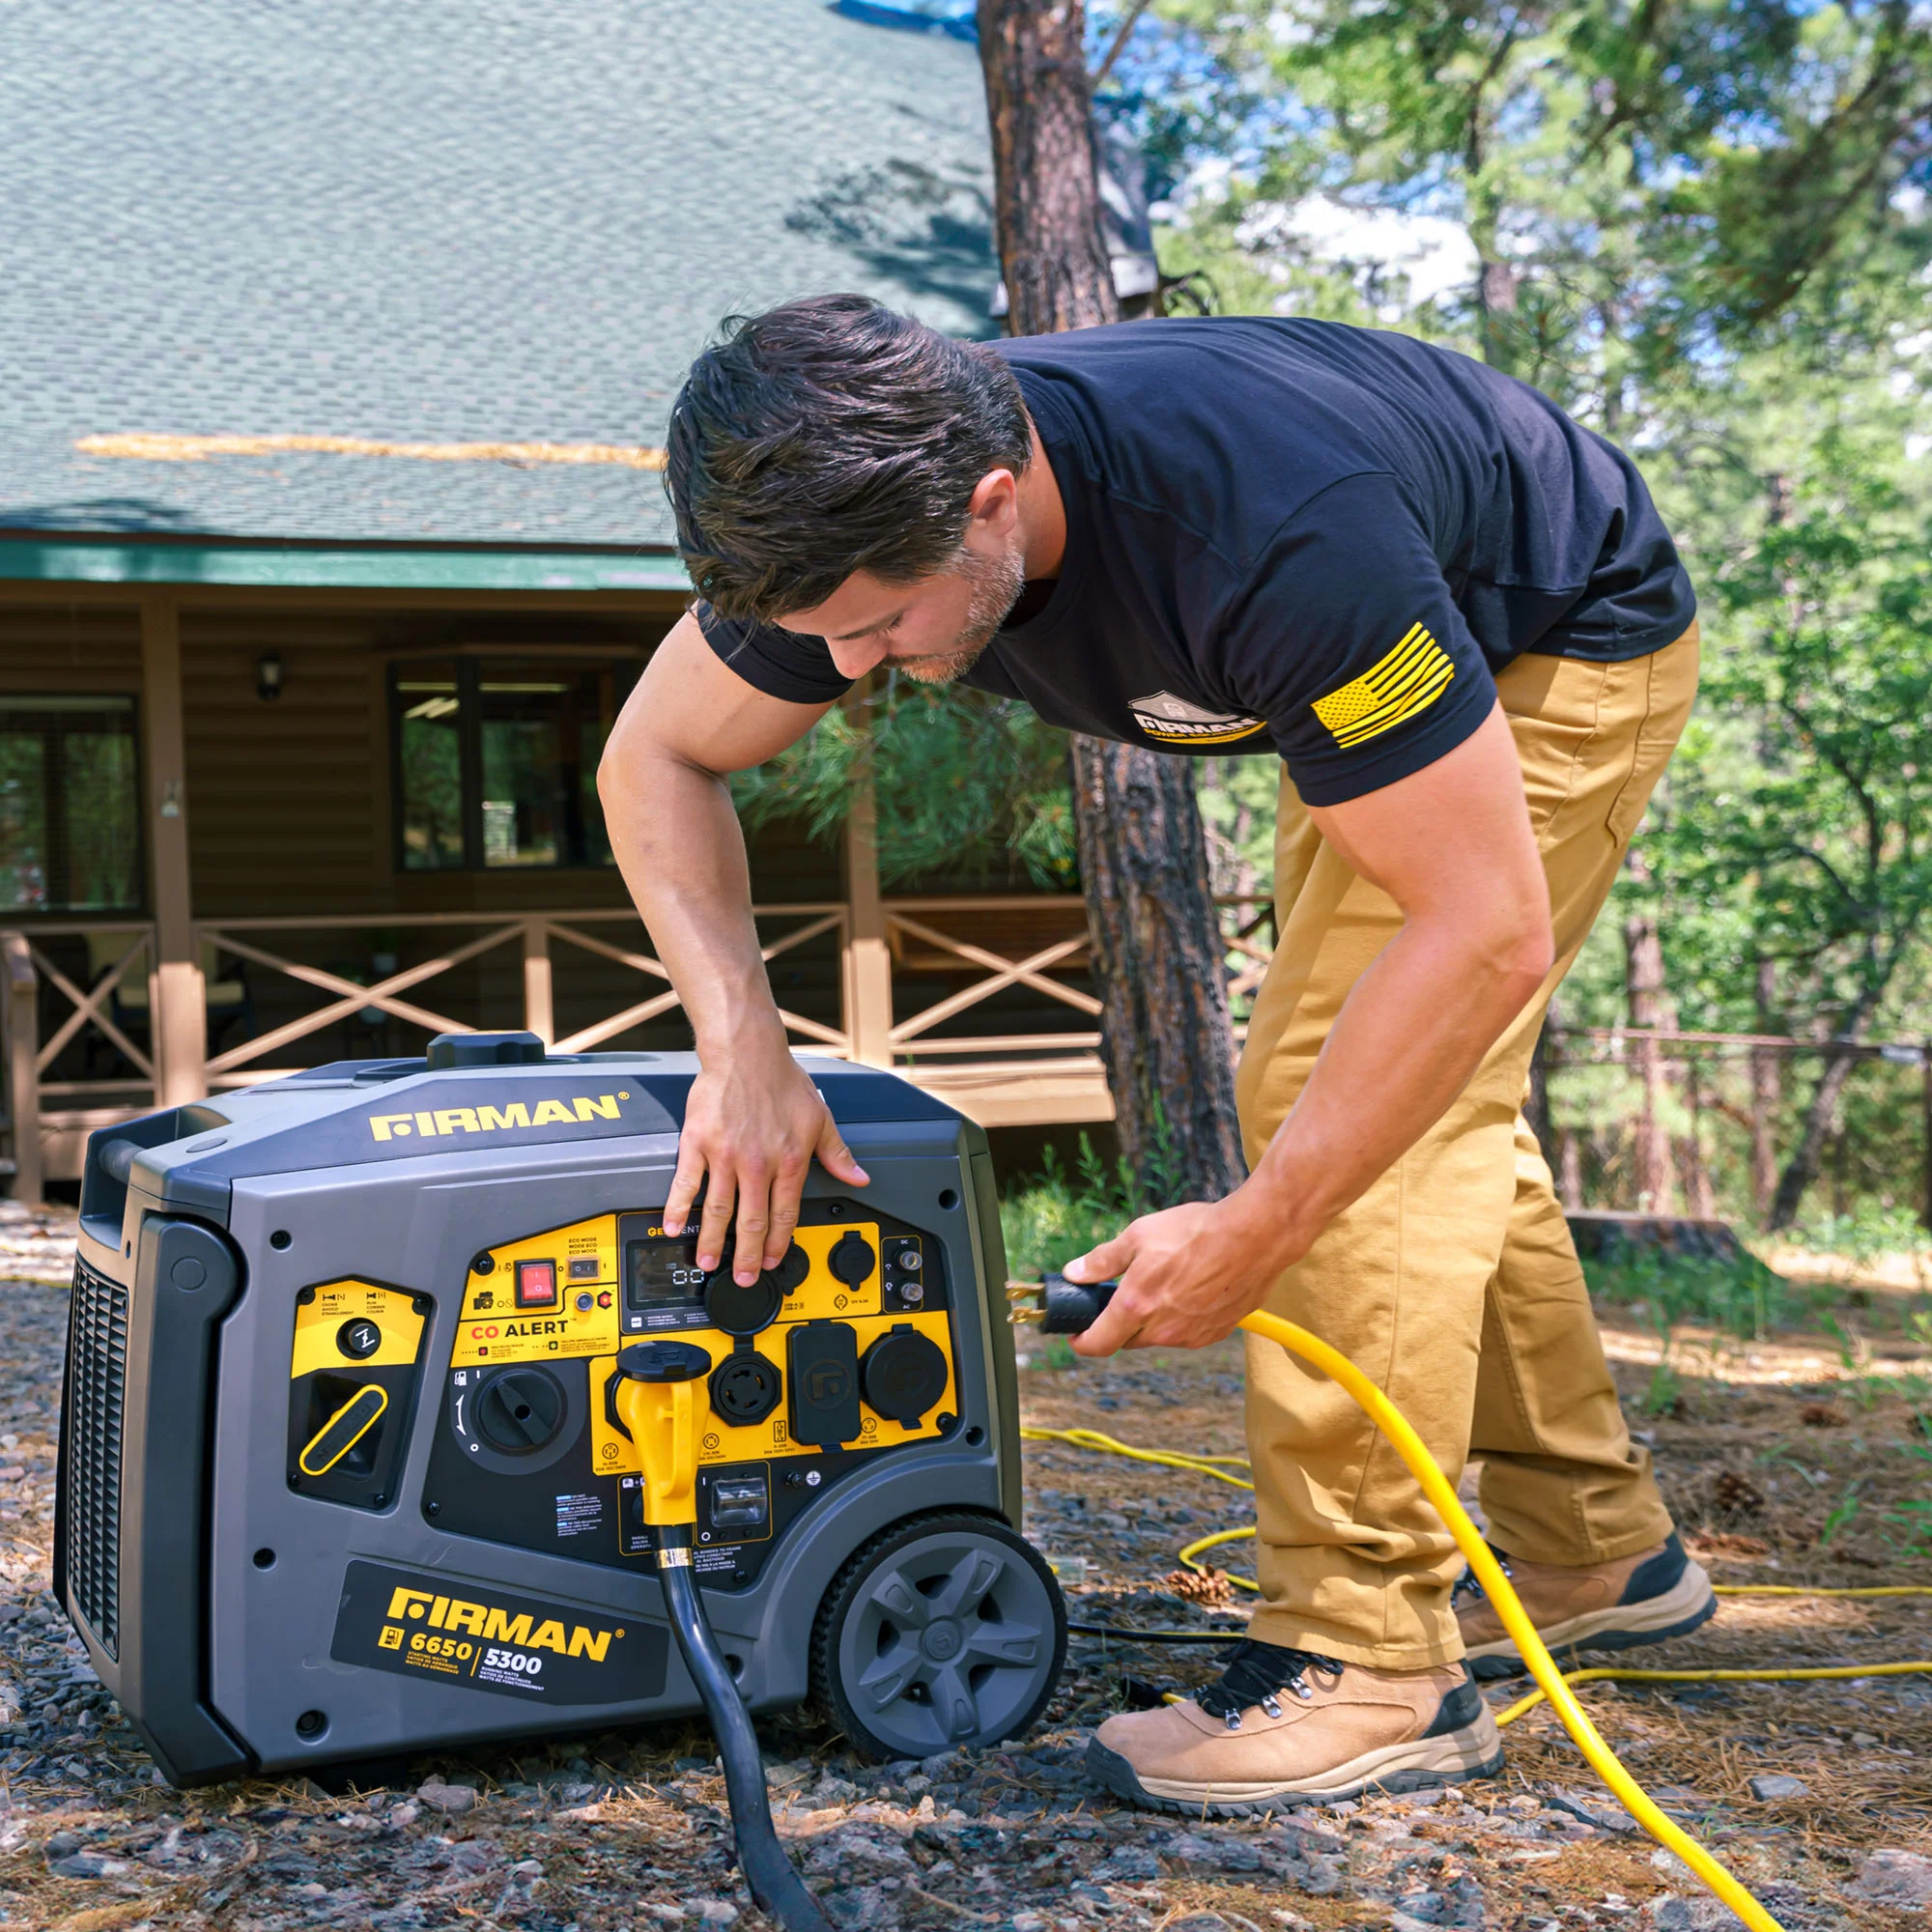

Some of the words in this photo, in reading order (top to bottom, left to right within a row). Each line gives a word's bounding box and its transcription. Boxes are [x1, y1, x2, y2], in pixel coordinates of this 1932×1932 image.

[1133, 713, 1260, 733] FIRMAN
[471, 1325, 499, 1340] CO
[410, 1633, 473, 1661] 6650
[483, 1647, 543, 1675] 5300
